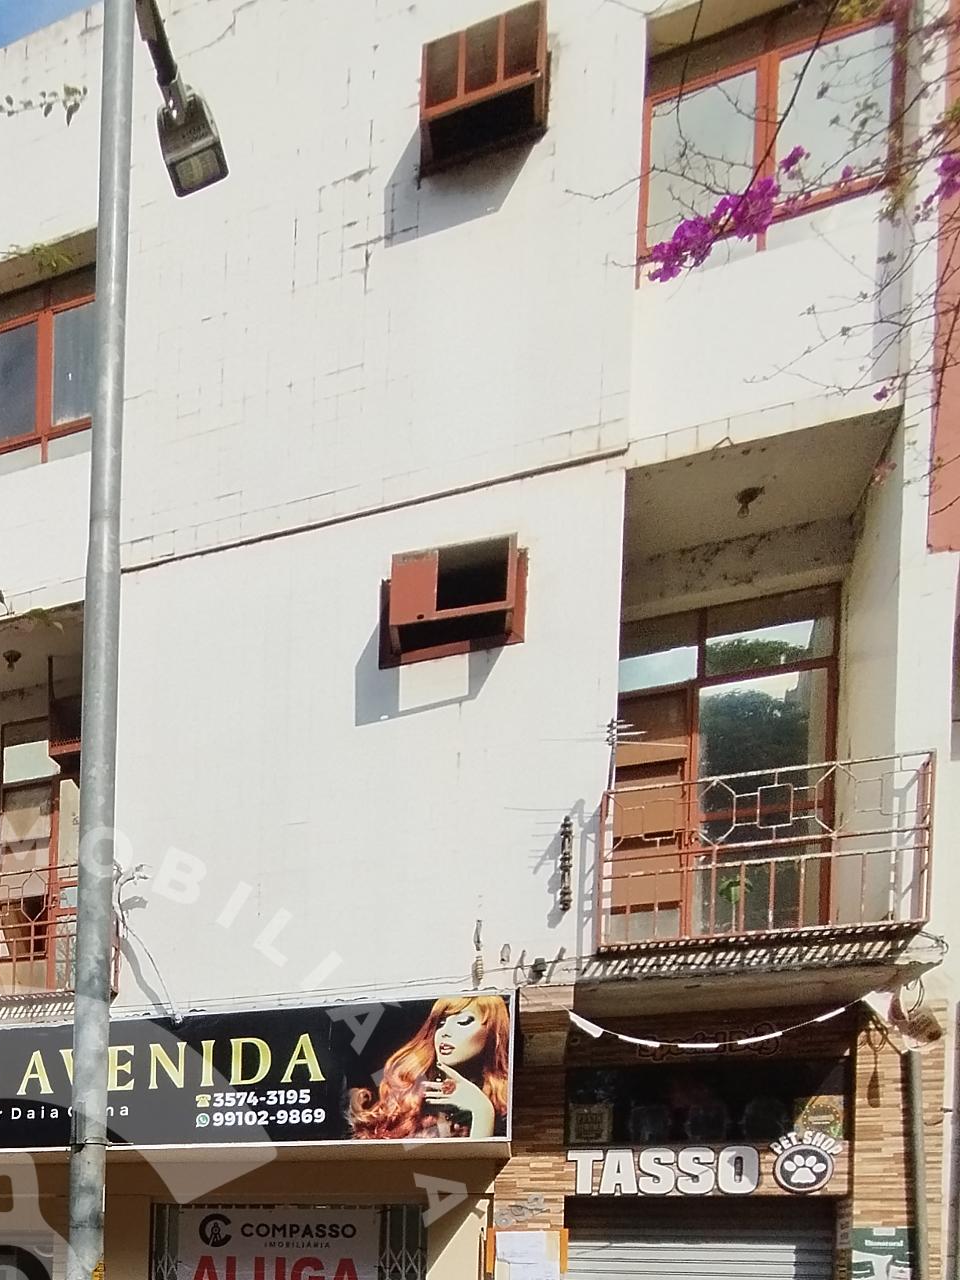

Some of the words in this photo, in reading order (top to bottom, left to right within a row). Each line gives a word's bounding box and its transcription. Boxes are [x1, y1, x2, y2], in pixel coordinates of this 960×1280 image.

[212, 1088, 311, 1108] 3574-3195
[11, 1106, 59, 1120] Daia
[212, 1108, 326, 1127] 99102-9869
[770, 1132, 801, 1155] PET
[803, 1131, 843, 1155] SHOP
[567, 1146, 759, 1195] TASSO
[241, 1223, 357, 1239] COMPASSO
[263, 1241, 330, 1249] IMOBILIÁRIA
